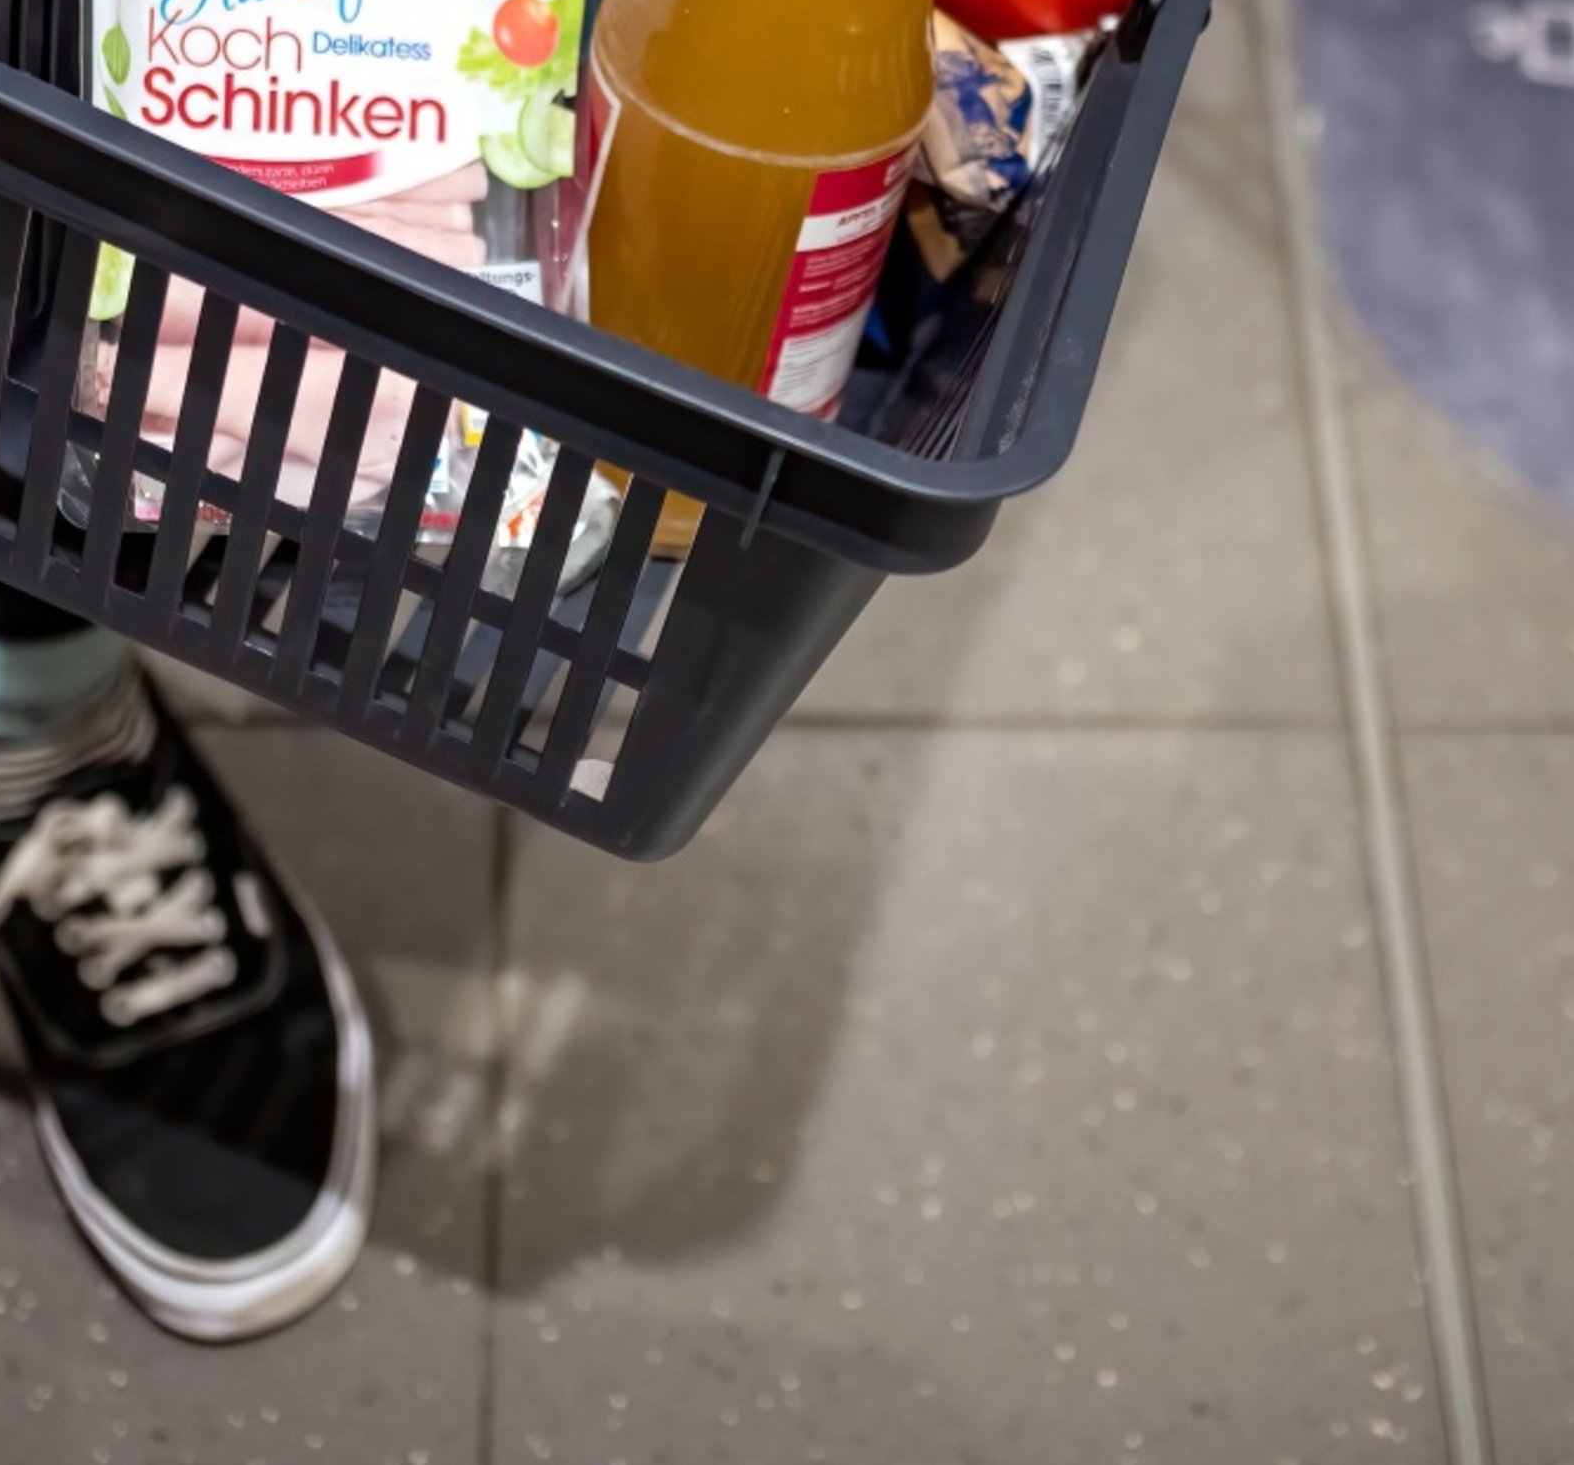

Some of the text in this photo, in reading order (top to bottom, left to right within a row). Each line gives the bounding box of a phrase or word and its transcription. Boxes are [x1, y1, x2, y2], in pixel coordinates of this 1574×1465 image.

[148, 6, 433, 74] Koch Delikatess
[140, 65, 448, 144] Schinken
